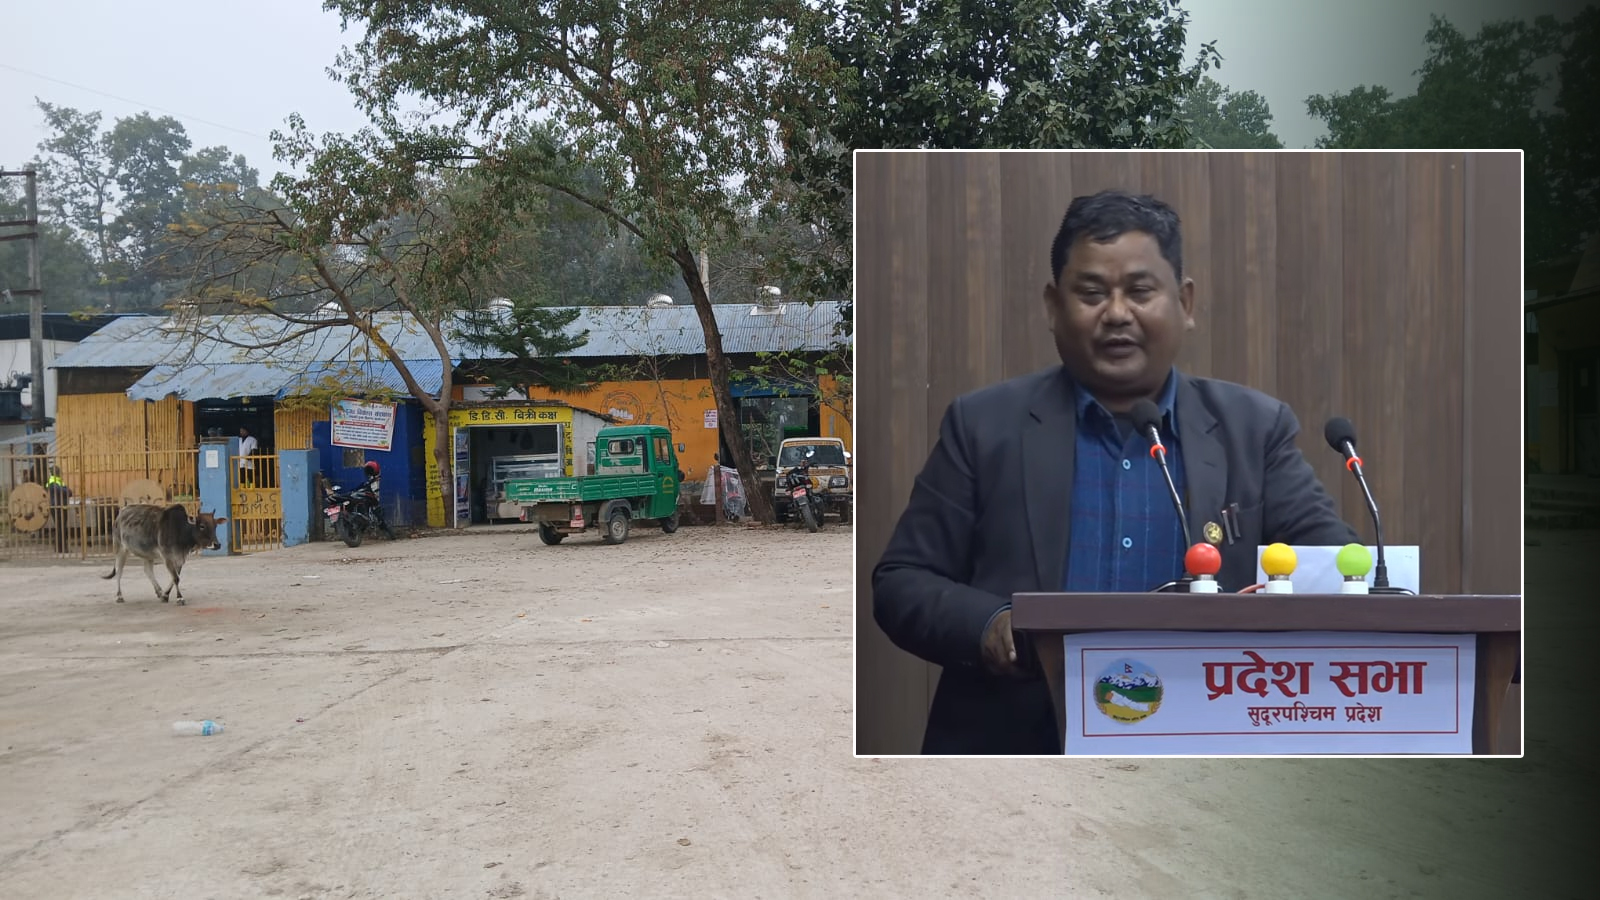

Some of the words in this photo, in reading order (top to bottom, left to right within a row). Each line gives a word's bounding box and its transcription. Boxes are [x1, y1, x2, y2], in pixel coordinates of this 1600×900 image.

[1202, 650, 1314, 701] प्रदेश
[1329, 661, 1428, 698] सभा
[1247, 702, 1337, 727] सुदूरपश्चिम
[1345, 705, 1383, 724] प्रदेश
